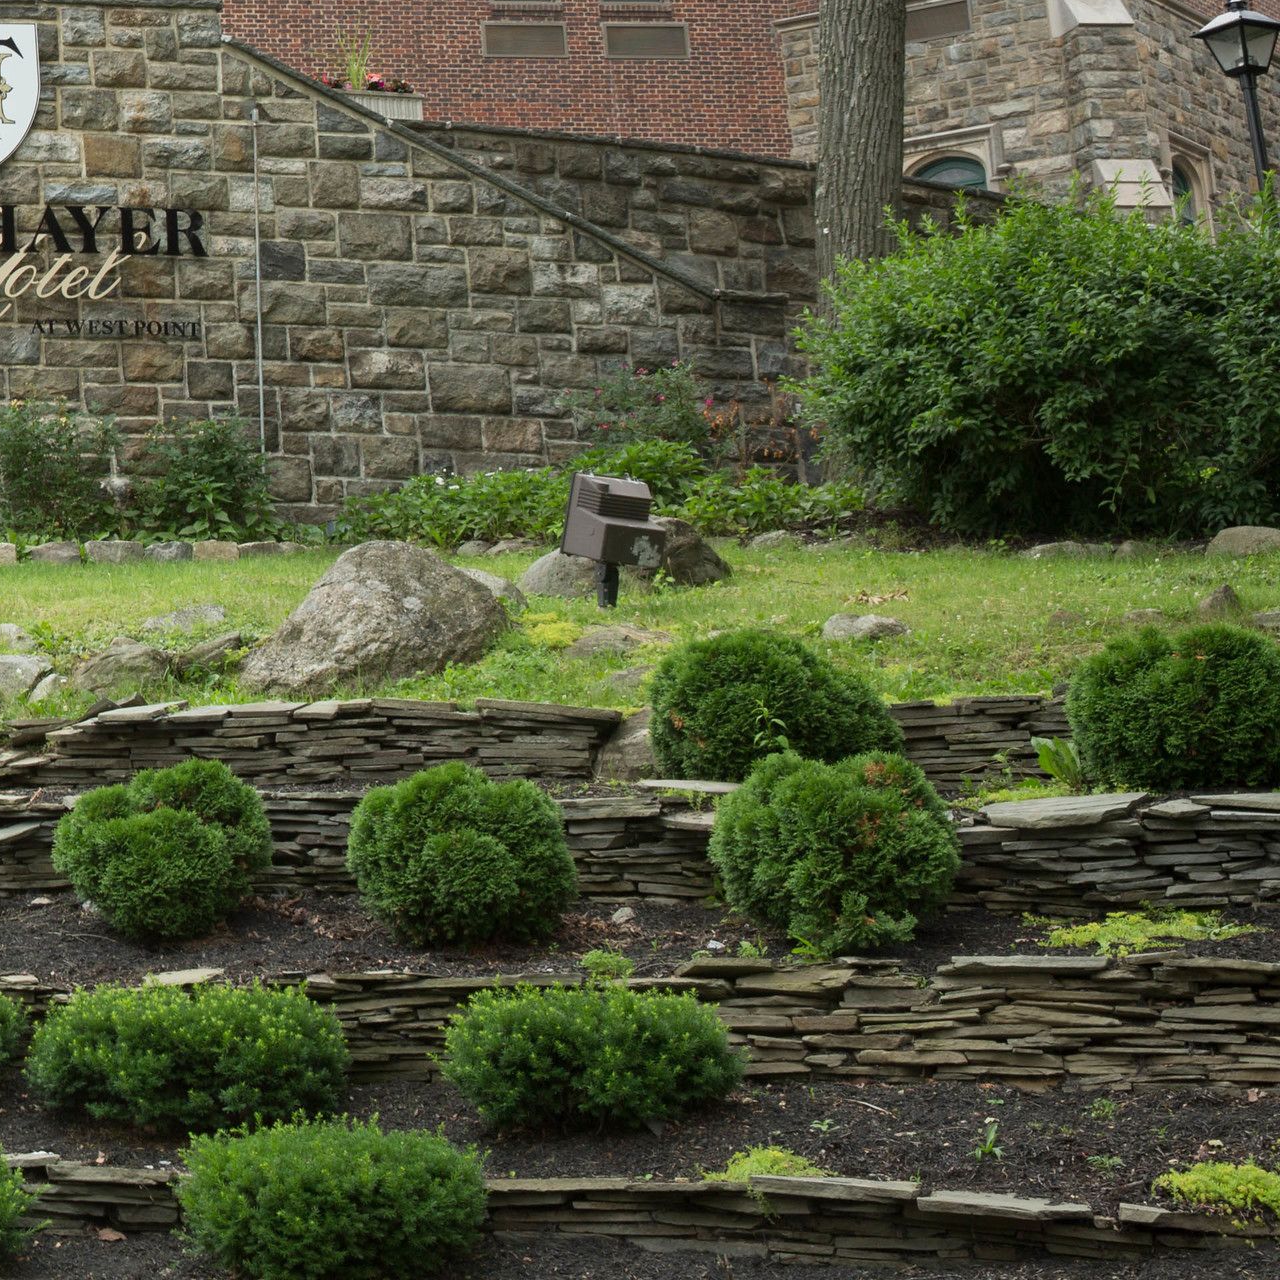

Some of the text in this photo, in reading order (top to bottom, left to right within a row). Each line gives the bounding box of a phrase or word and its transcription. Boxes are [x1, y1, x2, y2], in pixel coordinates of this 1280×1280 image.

[32, 320, 202, 338] AT WEST POINT
